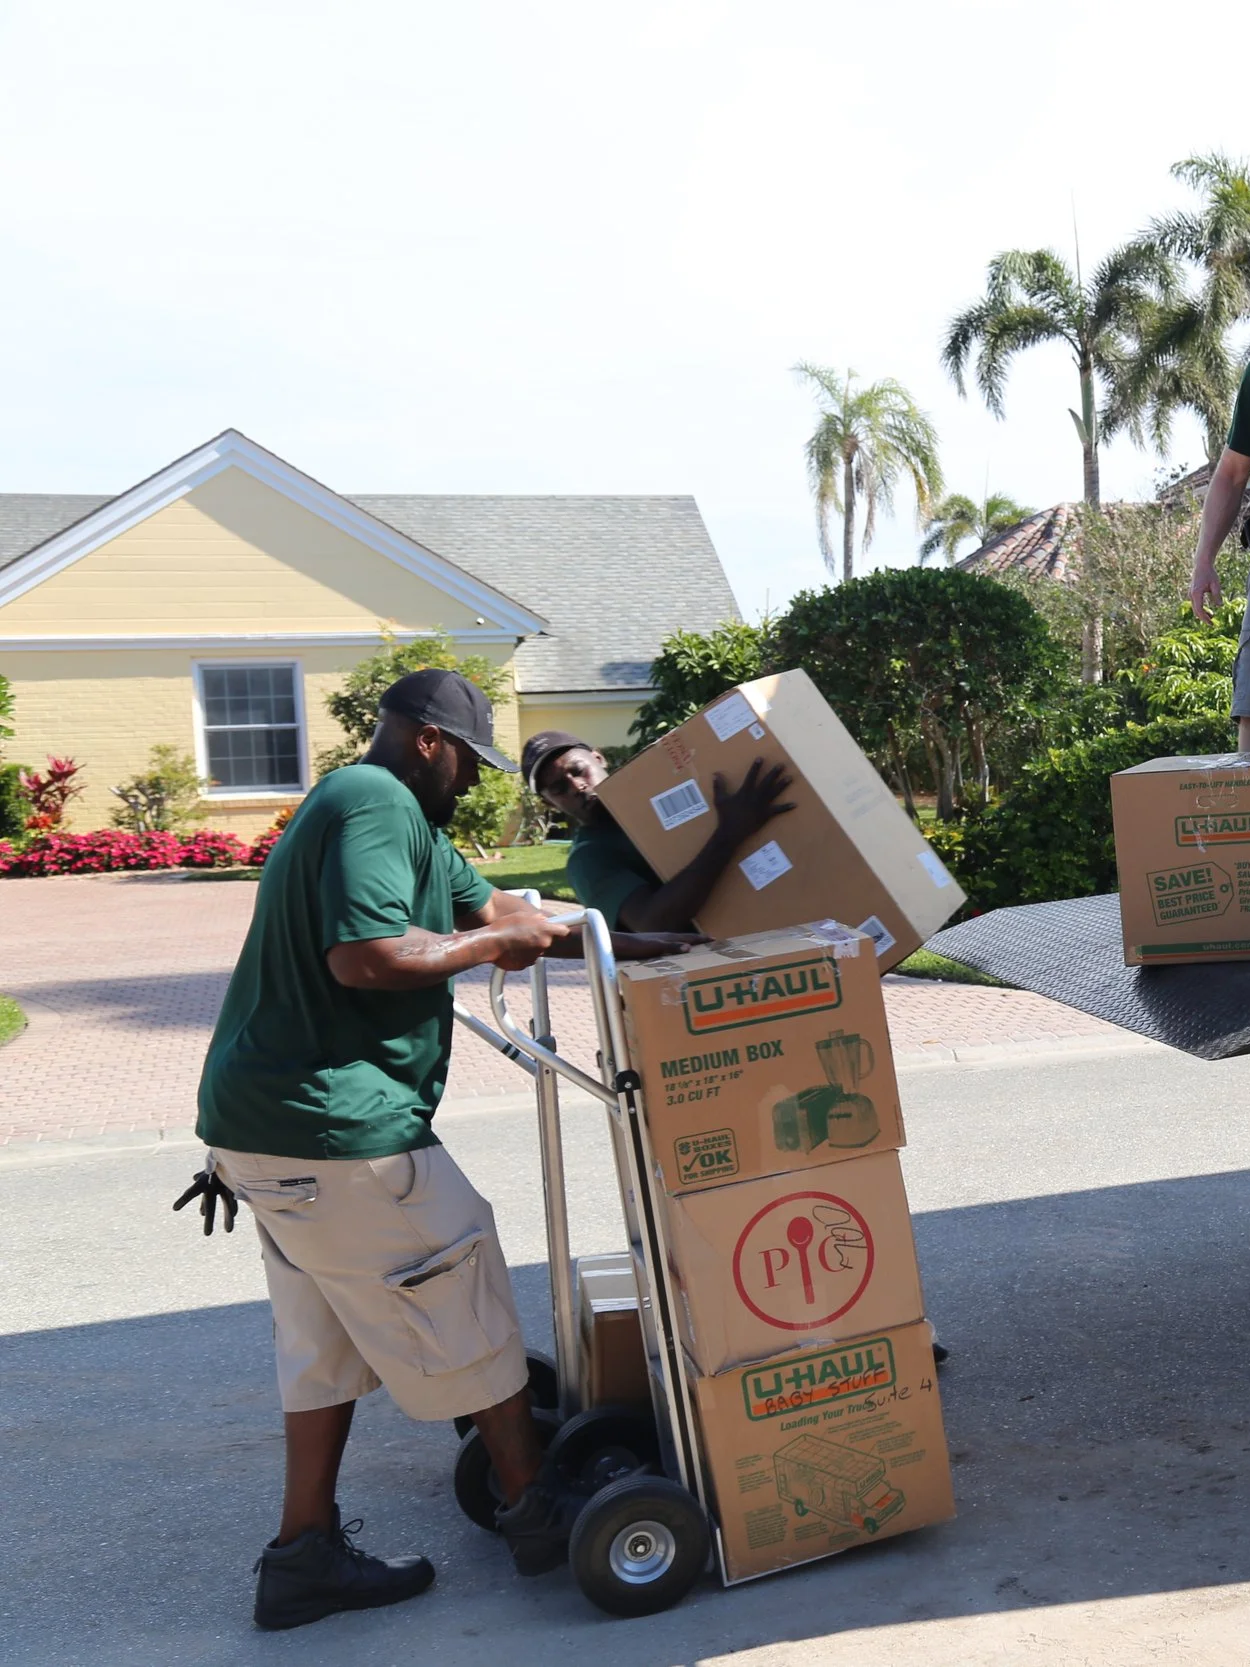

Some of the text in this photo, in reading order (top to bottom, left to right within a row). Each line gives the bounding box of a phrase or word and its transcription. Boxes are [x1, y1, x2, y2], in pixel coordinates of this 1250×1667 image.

[1154, 868, 1213, 891] SAVE!
[1158, 890, 1215, 909] BEST PRICE
[693, 966, 830, 1012] U-HAUL
[660, 1039, 784, 1079] MEDIUM BOX
[666, 1086, 721, 1106] 3.0 CU FT
[700, 1149, 734, 1168] OK
[753, 1348, 885, 1399] U-HAUL
[828, 1367, 887, 1397] STUFF
[920, 1376, 932, 1392] 4
[780, 1413, 820, 1432] Loading
[822, 1408, 845, 1421] Your
